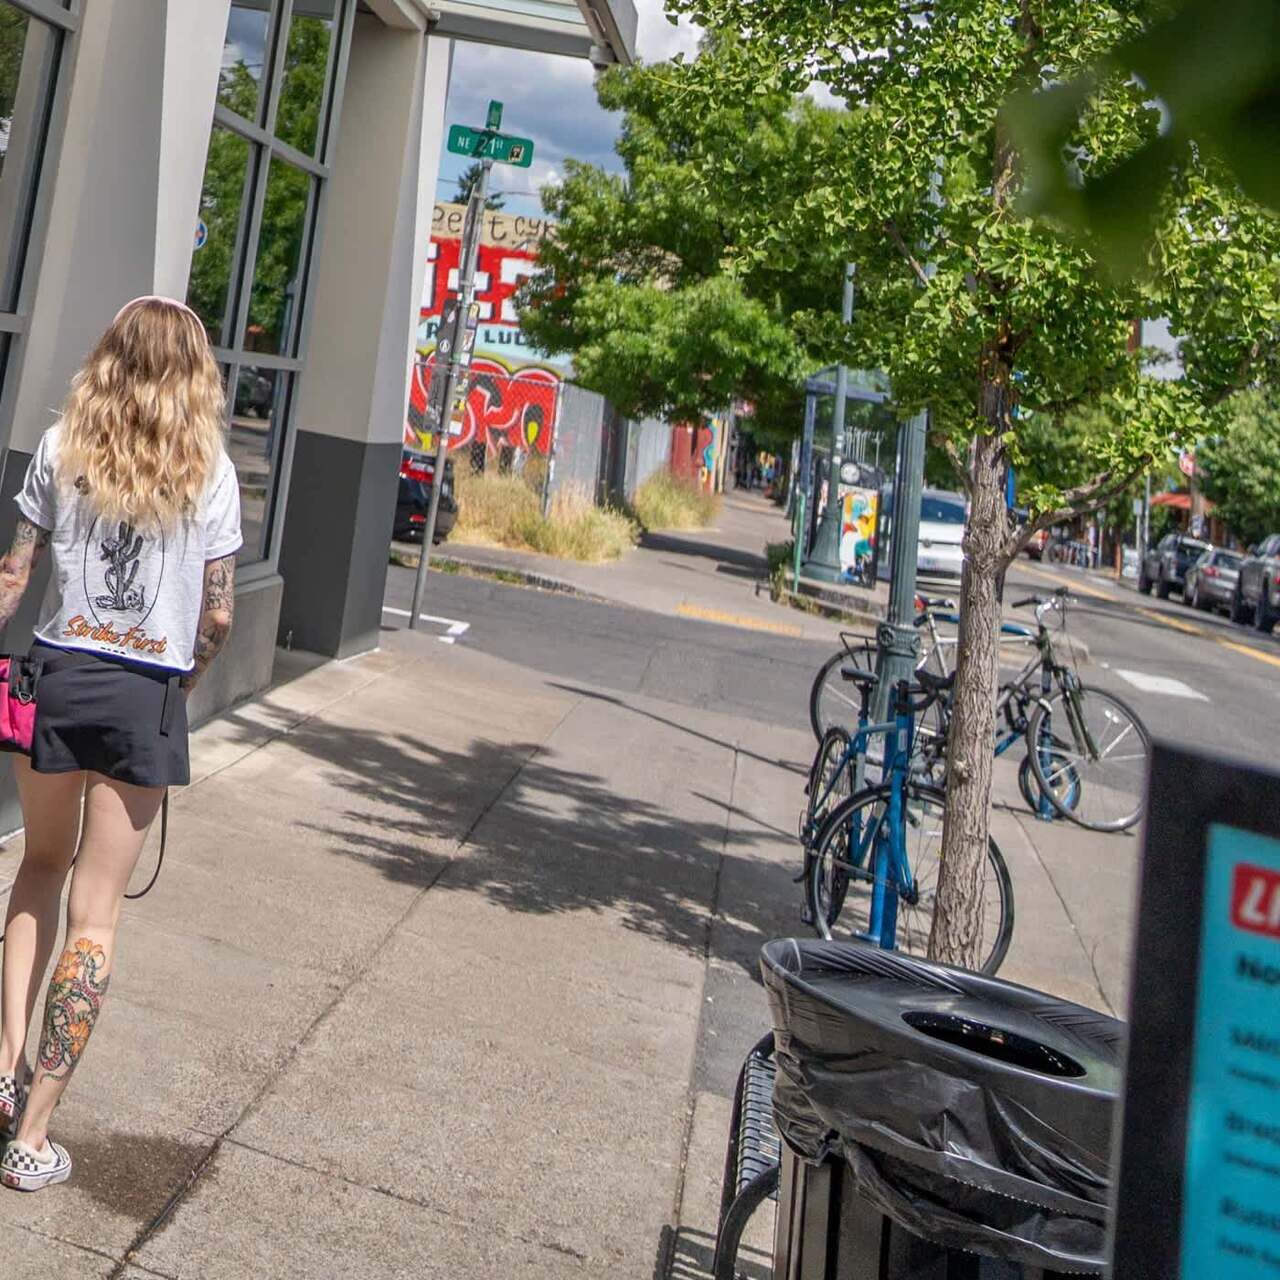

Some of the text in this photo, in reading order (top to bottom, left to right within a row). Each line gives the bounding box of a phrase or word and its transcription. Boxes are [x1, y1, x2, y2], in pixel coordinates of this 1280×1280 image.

[457, 136, 470, 150] NE
[62, 614, 168, 654] Strike First
